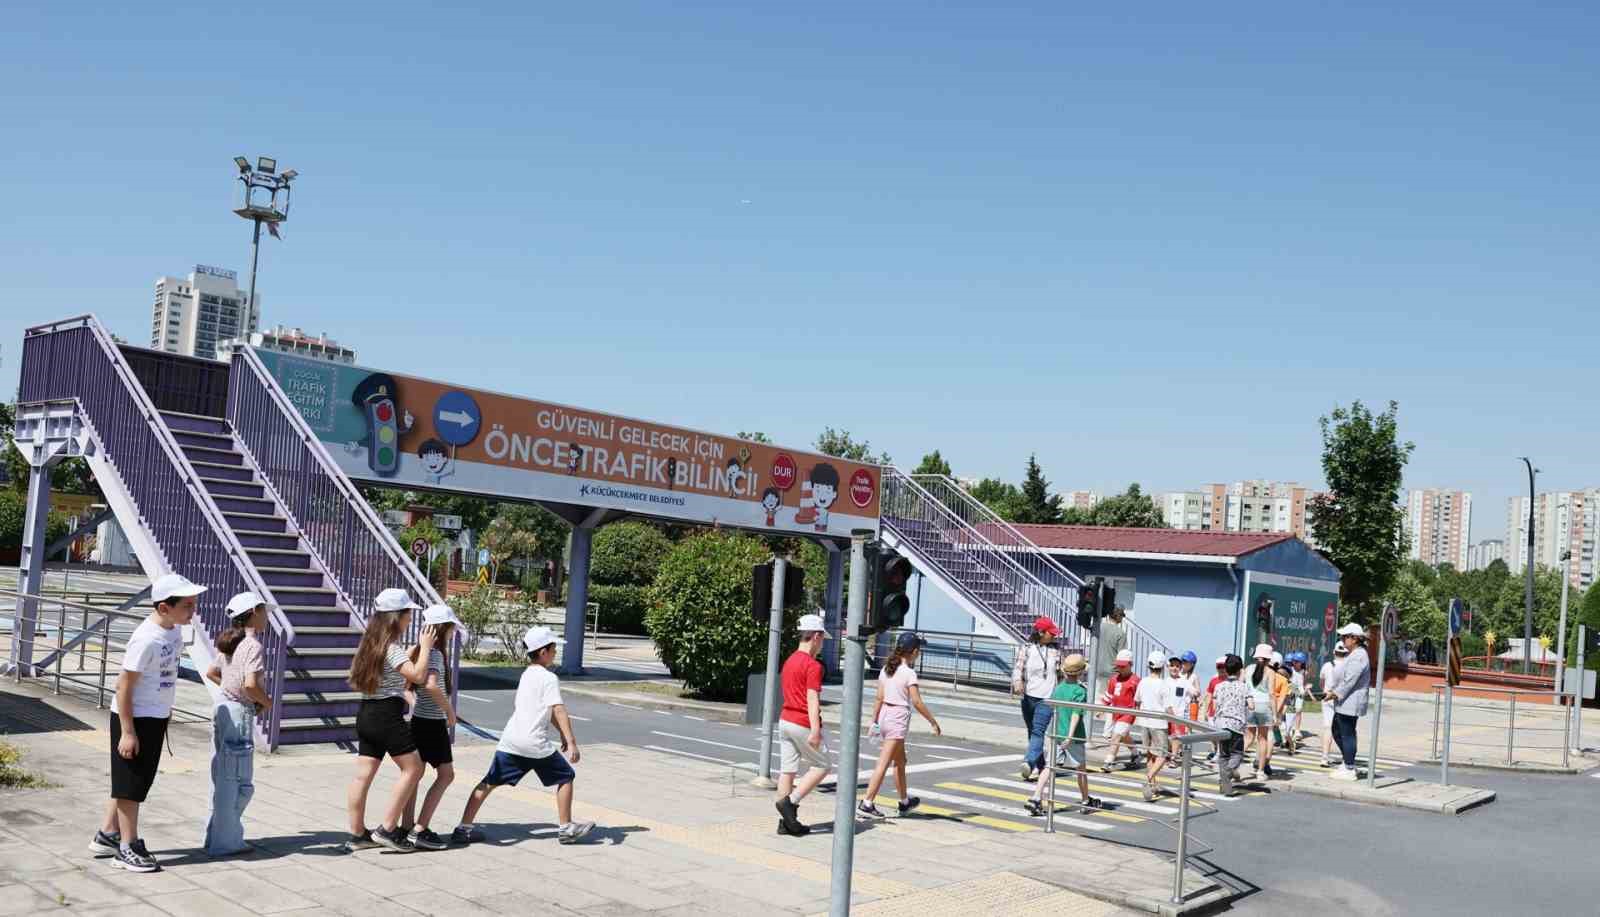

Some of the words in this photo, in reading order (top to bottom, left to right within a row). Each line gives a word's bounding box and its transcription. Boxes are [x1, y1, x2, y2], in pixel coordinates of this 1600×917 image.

[288, 379, 326, 395] TRAFİK
[536, 408, 615, 441] GÜVENLİ
[619, 426, 689, 454] GELECEK
[694, 435, 724, 460] İÇİN
[484, 423, 569, 469] ÖNCE
[579, 446, 667, 484] TRAFİK
[675, 457, 758, 497] BİLİNCİ!
[774, 464, 792, 478] DUR
[649, 494, 685, 506] BELEDİYESİ
